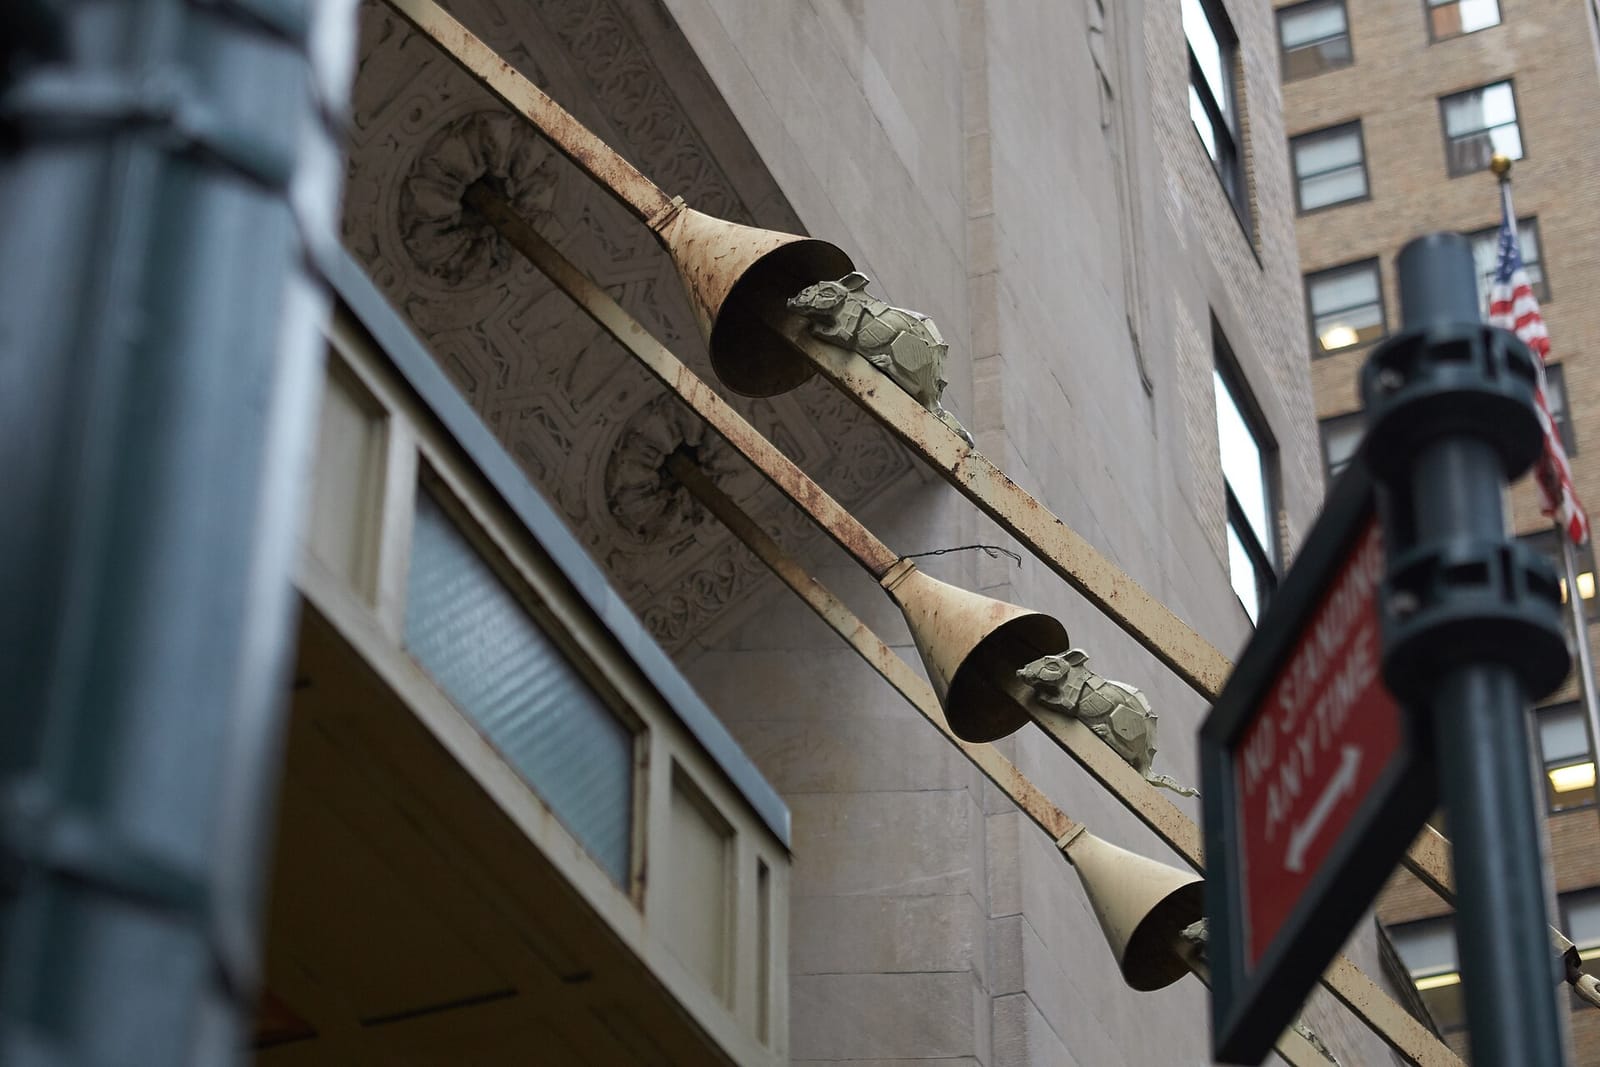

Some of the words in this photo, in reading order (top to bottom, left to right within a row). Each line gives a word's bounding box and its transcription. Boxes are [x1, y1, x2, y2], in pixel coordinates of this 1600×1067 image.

[1244, 714, 1276, 796] NO
[1279, 524, 1386, 734] STANDING
[1264, 624, 1378, 841] ANYTIME
